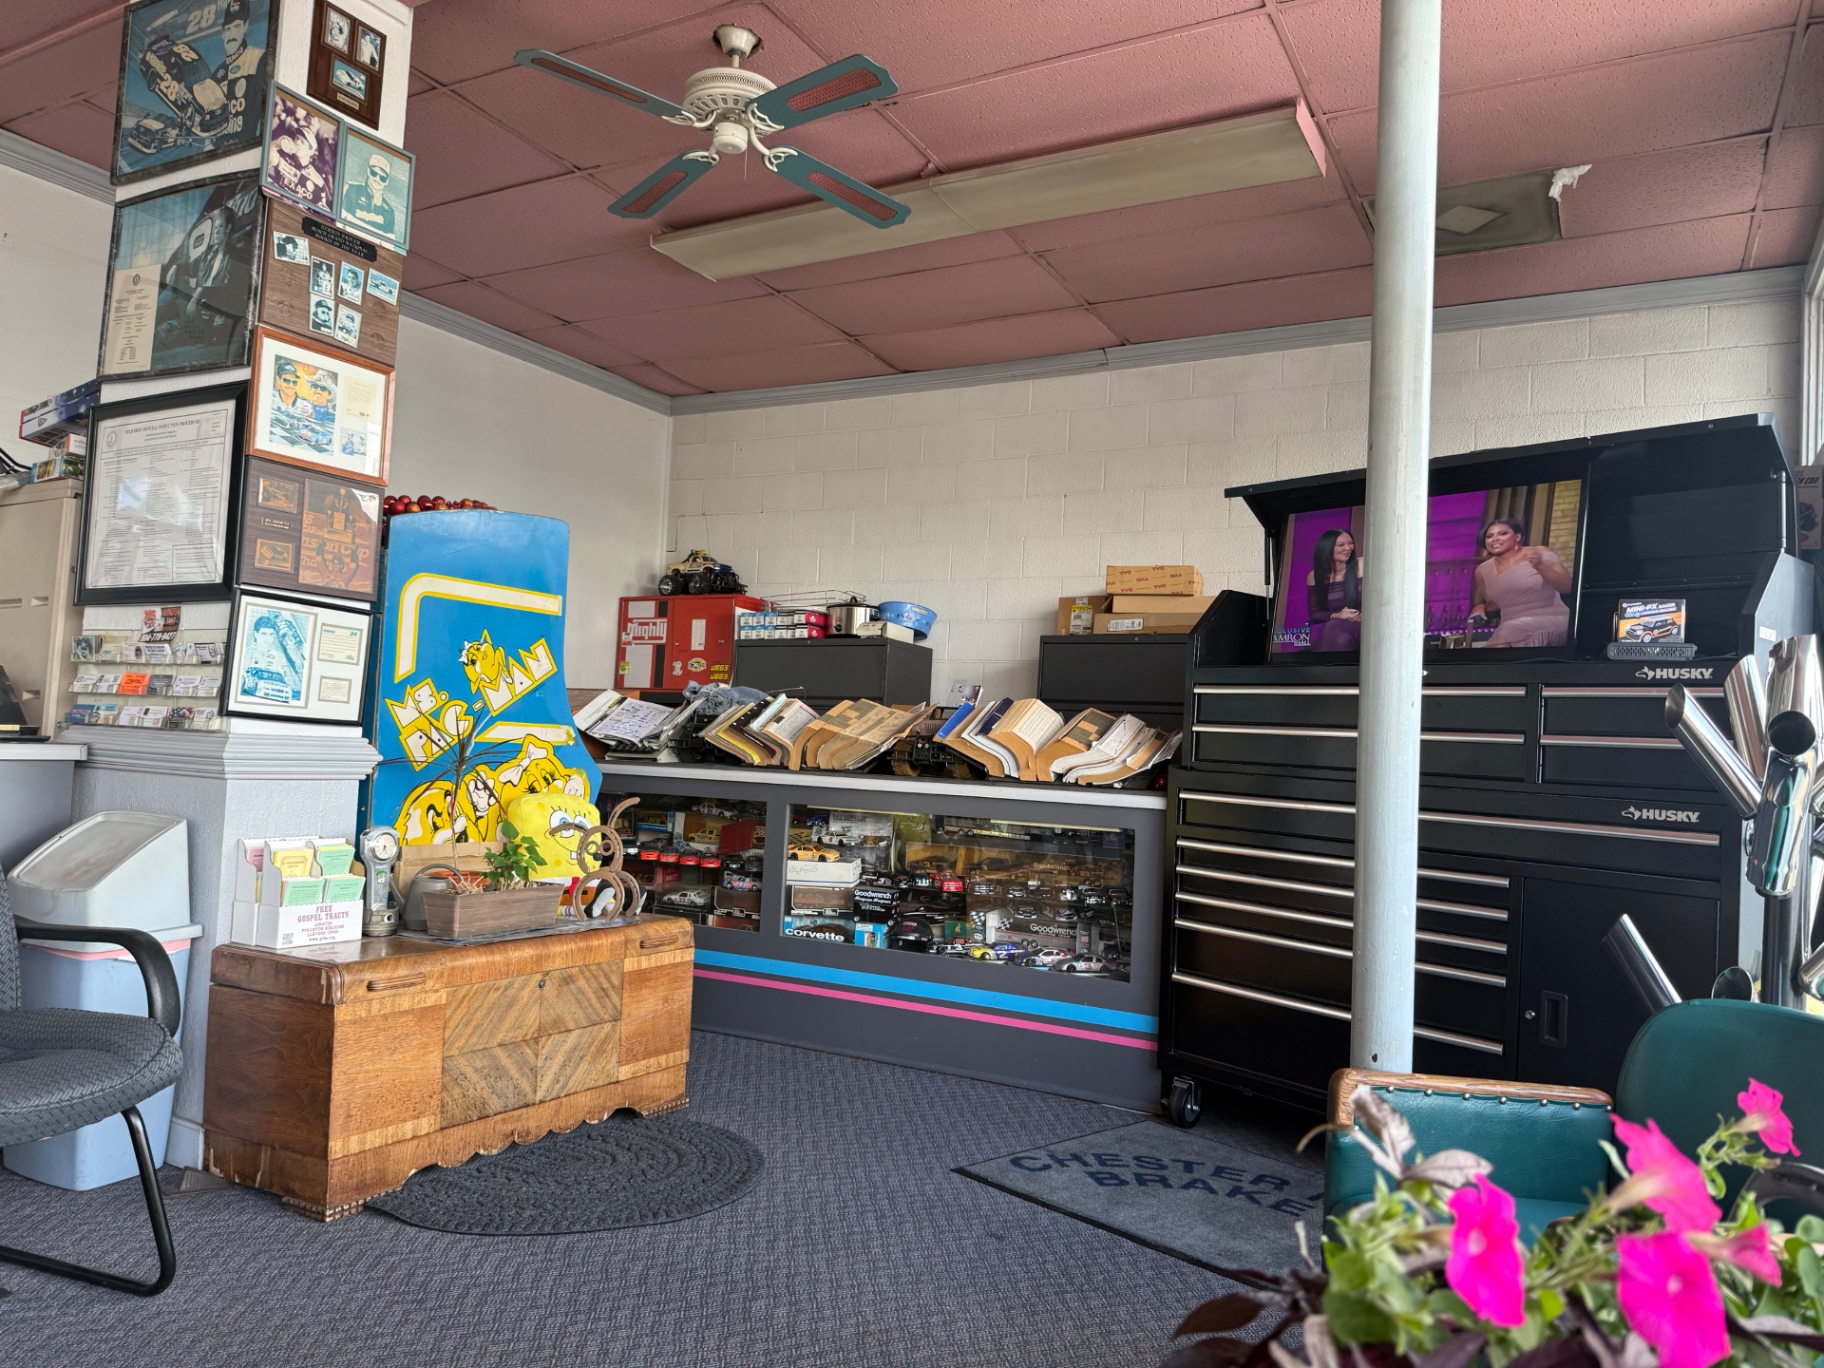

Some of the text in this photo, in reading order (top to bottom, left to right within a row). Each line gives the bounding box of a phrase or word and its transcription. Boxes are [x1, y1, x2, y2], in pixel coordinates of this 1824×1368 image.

[185, 5, 216, 34] 28
[160, 74, 179, 101] 28
[627, 619, 668, 643] Mighty
[1655, 668, 1714, 679] HUSKY
[1642, 808, 1700, 823] HUSKY
[854, 889, 892, 899] Goodwrench
[315, 905, 333, 913] FREE
[297, 911, 349, 923] GOSPEL TRACTS
[785, 928, 845, 942] corvette
[997, 950, 1008, 958] 2
[1009, 1152, 1291, 1194] CHESTER
[1084, 1170, 1316, 1217] BRAKE
